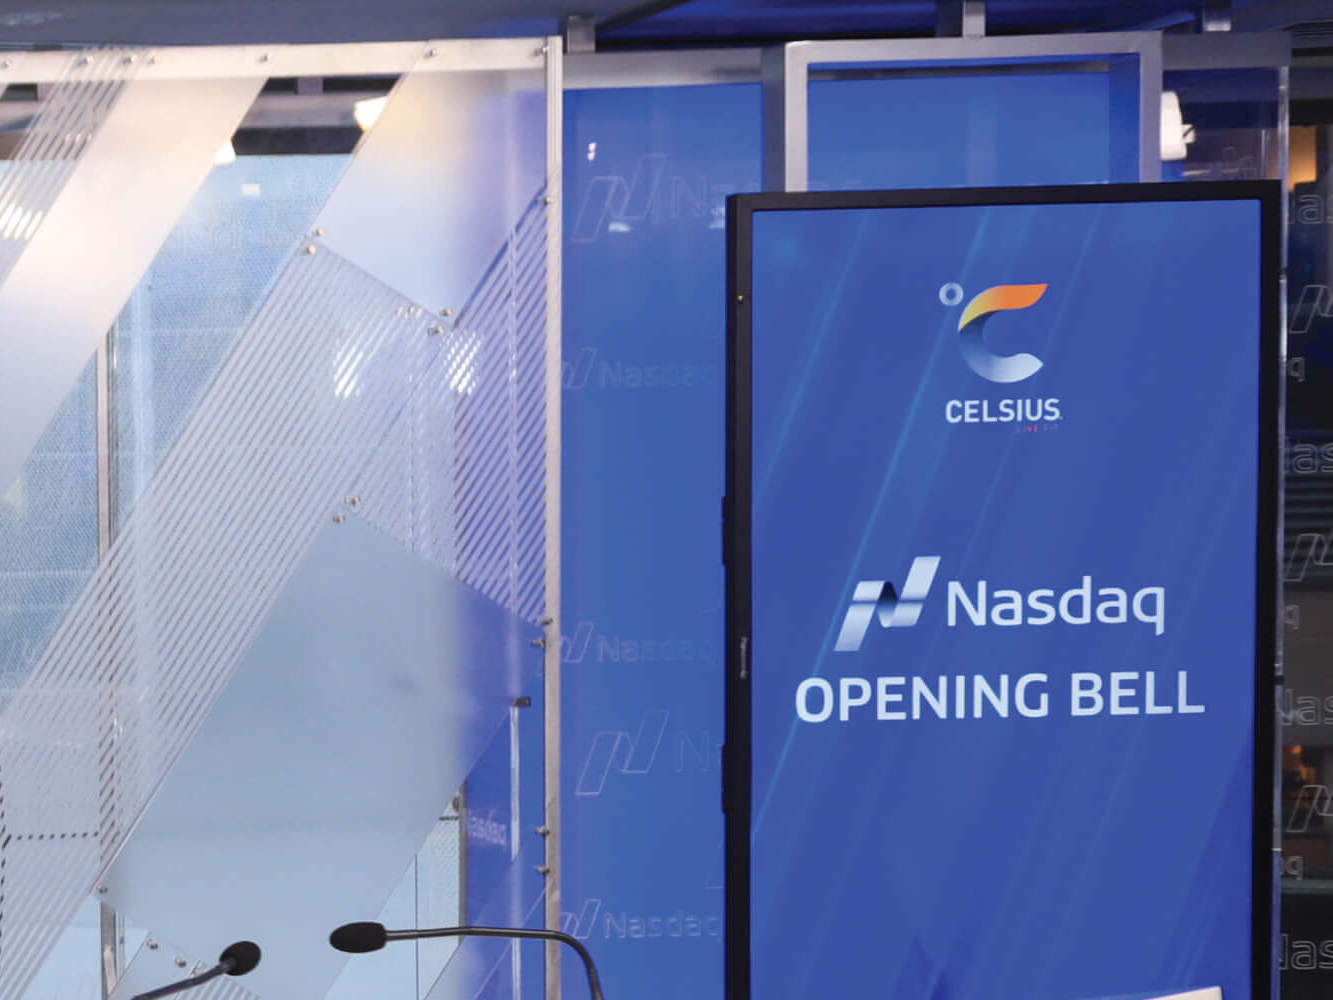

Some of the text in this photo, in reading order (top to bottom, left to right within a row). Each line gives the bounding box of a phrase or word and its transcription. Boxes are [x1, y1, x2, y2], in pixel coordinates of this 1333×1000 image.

[945, 397, 1063, 423] CELSIUS
[946, 575, 1166, 637] Nasdaq
[794, 670, 1206, 723] OPENING BELL
